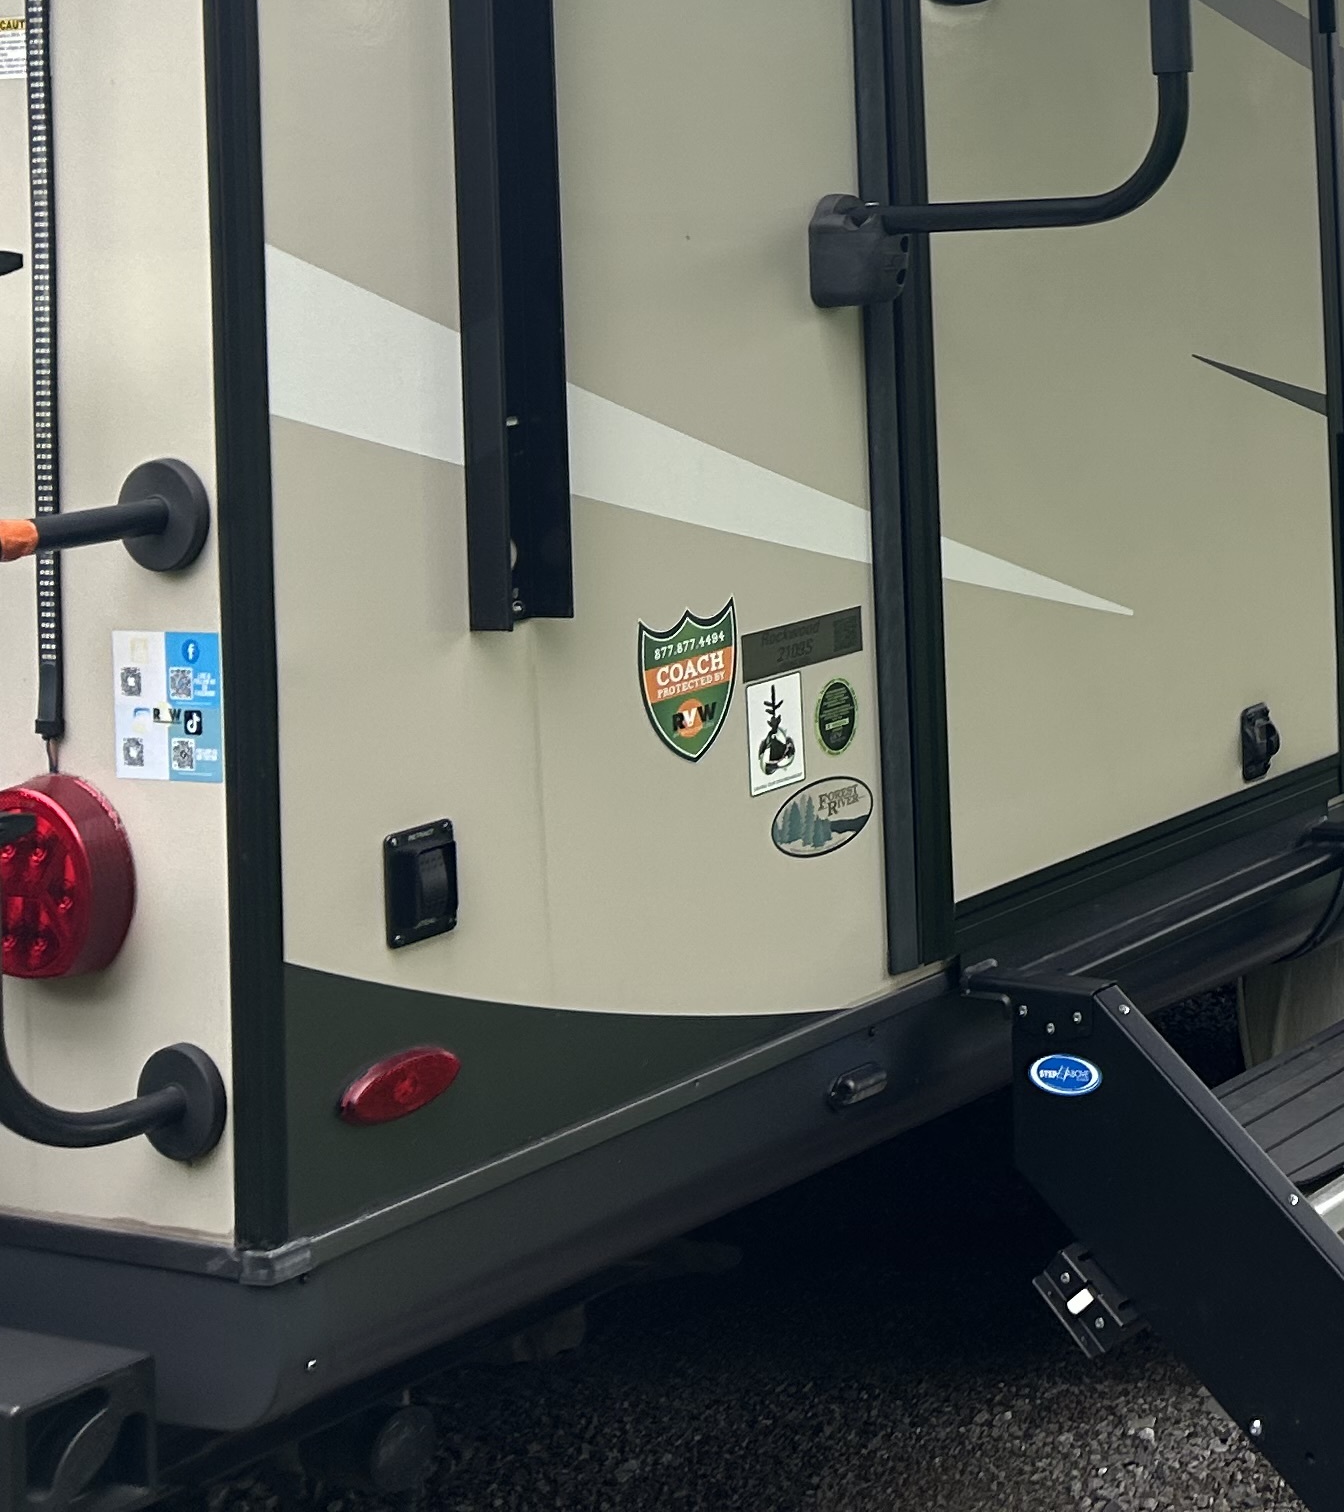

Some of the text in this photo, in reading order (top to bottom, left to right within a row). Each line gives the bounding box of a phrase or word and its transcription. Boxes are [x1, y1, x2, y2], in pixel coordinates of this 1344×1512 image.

[653, 630, 725, 661] 877.877.4494
[656, 650, 725, 686] COACH
[657, 670, 726, 699] PROTECTED BY
[672, 702, 717, 731] RVW
[818, 784, 860, 812] FOREST
[828, 794, 860, 817] RIVER
